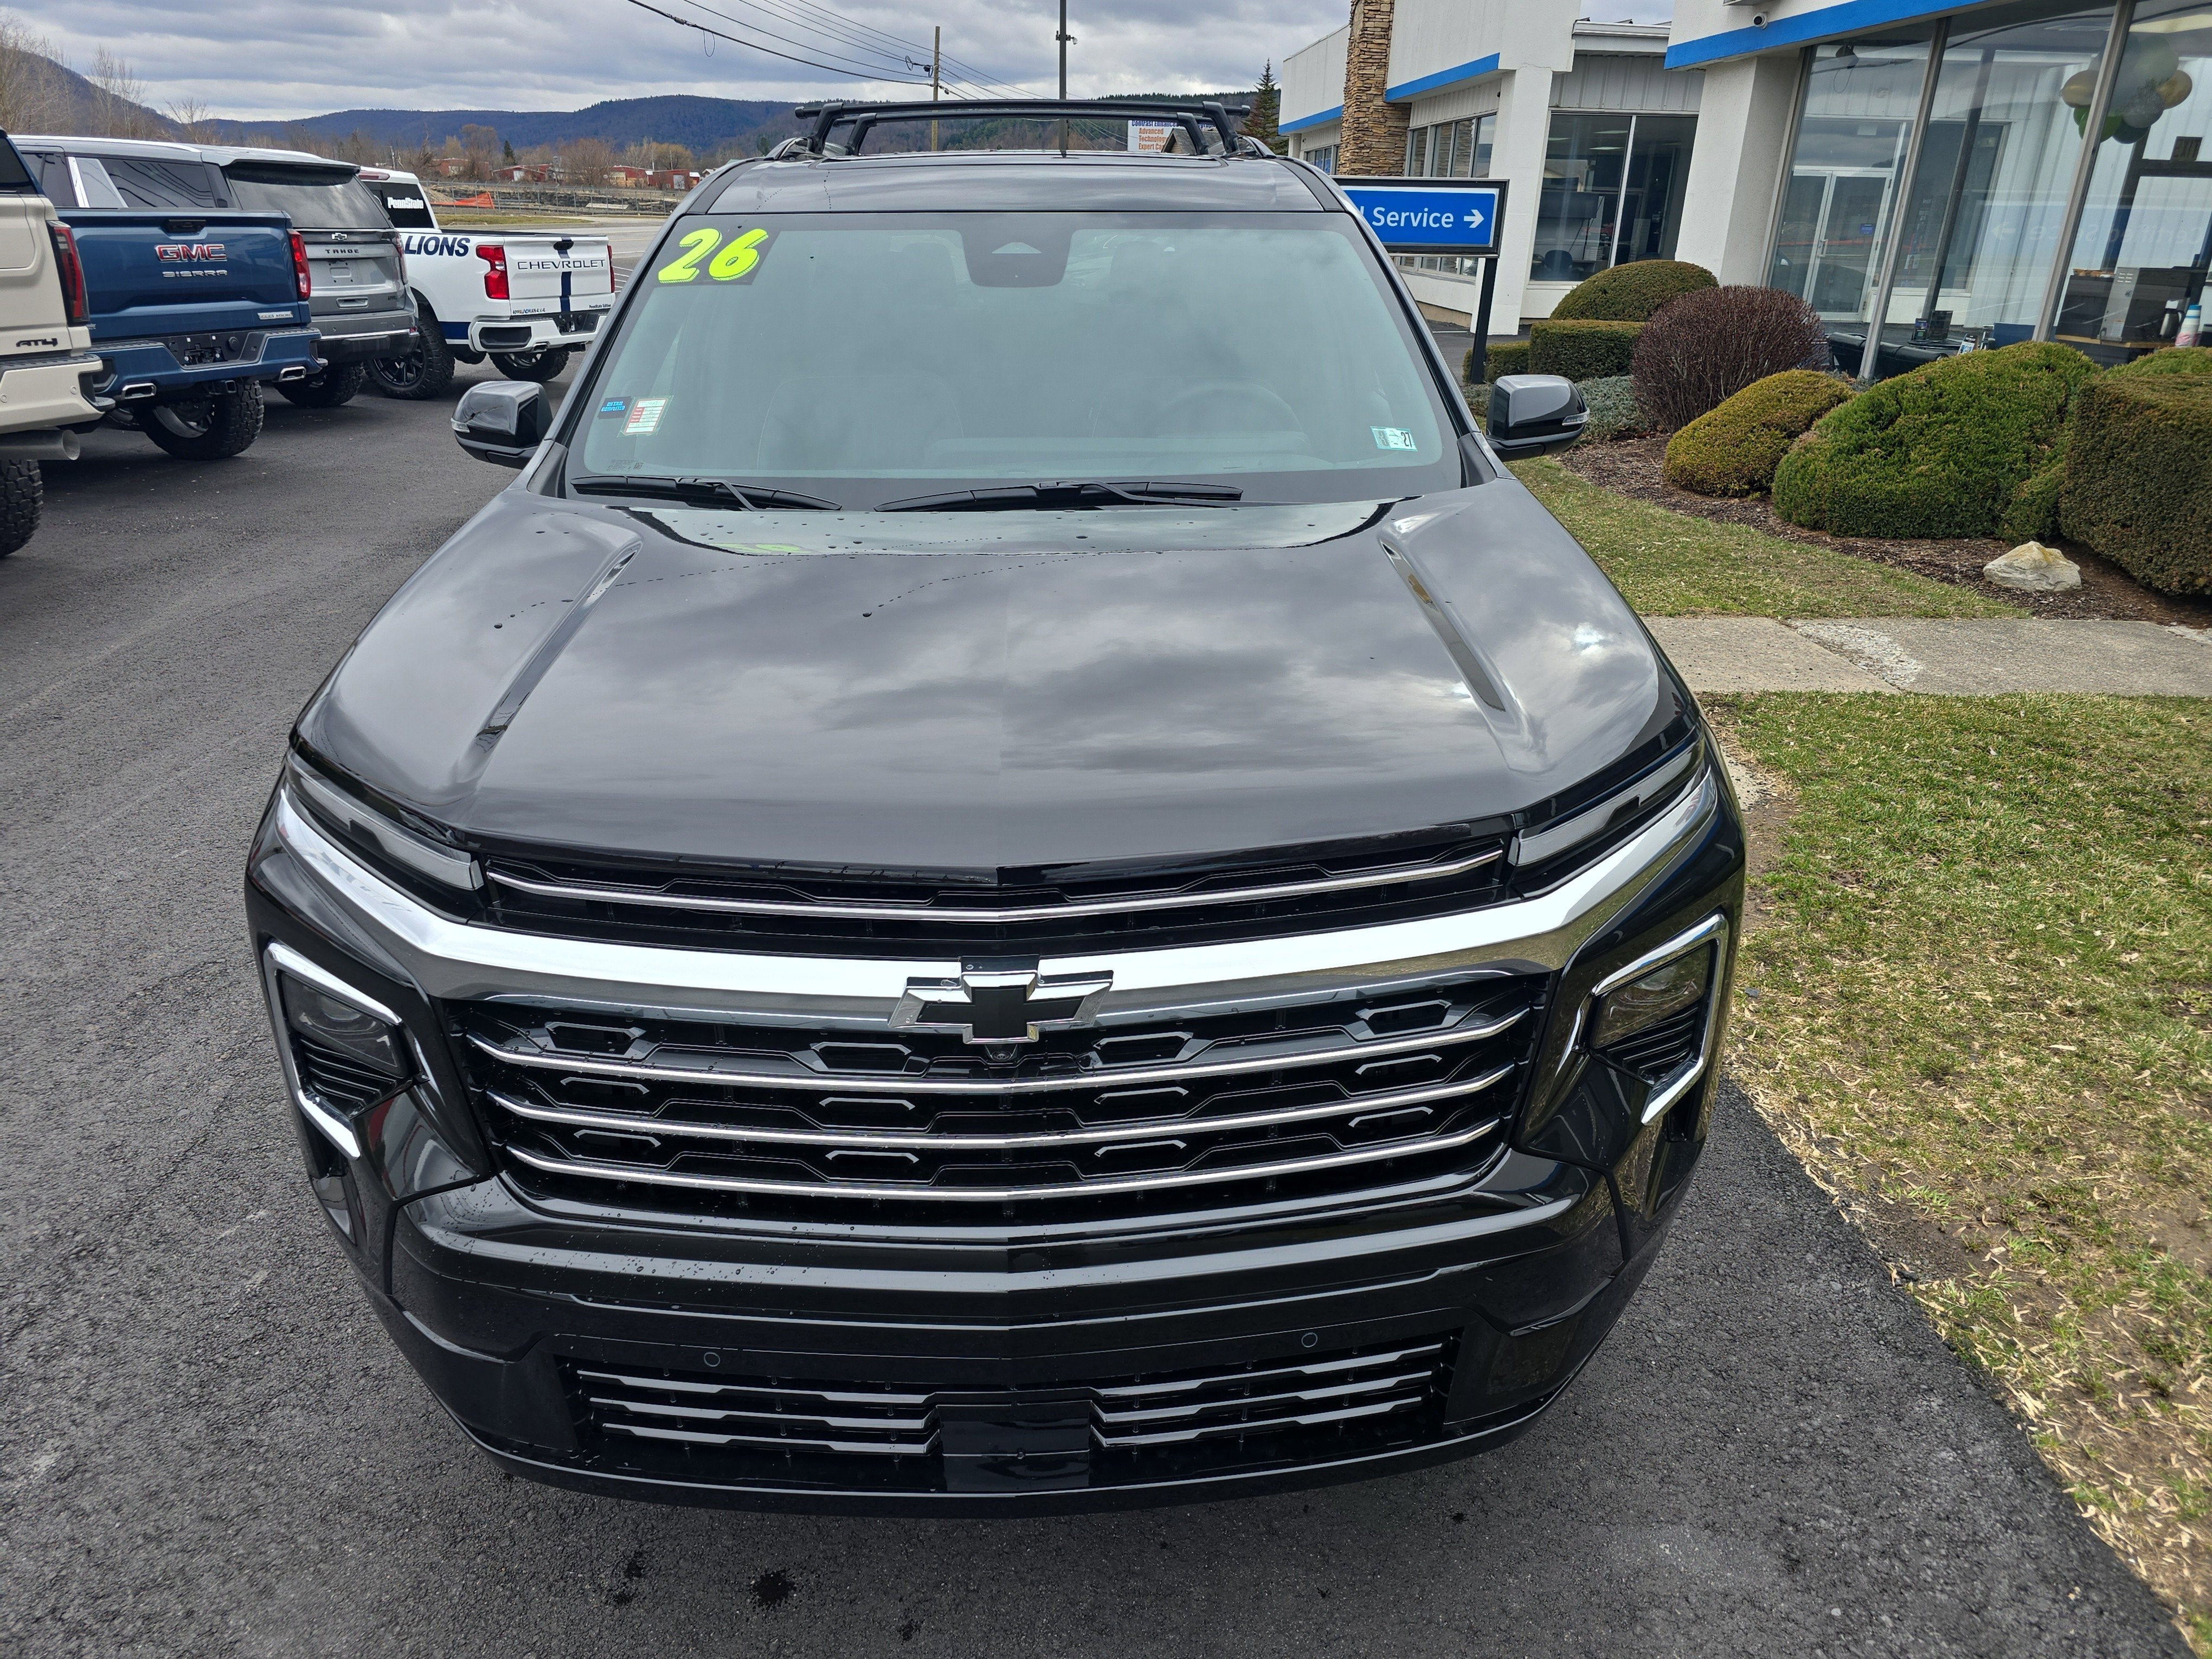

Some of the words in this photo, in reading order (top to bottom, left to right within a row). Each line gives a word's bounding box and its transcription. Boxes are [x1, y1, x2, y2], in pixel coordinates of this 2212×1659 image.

[1372, 207, 1454, 228] Service
[155, 243, 228, 263] GMC
[404, 235, 471, 257] LIONS
[658, 228, 769, 284] 26
[517, 259, 606, 270] CHEVROLET
[16, 338, 58, 348] AT4
[1401, 432, 1412, 448] 27
